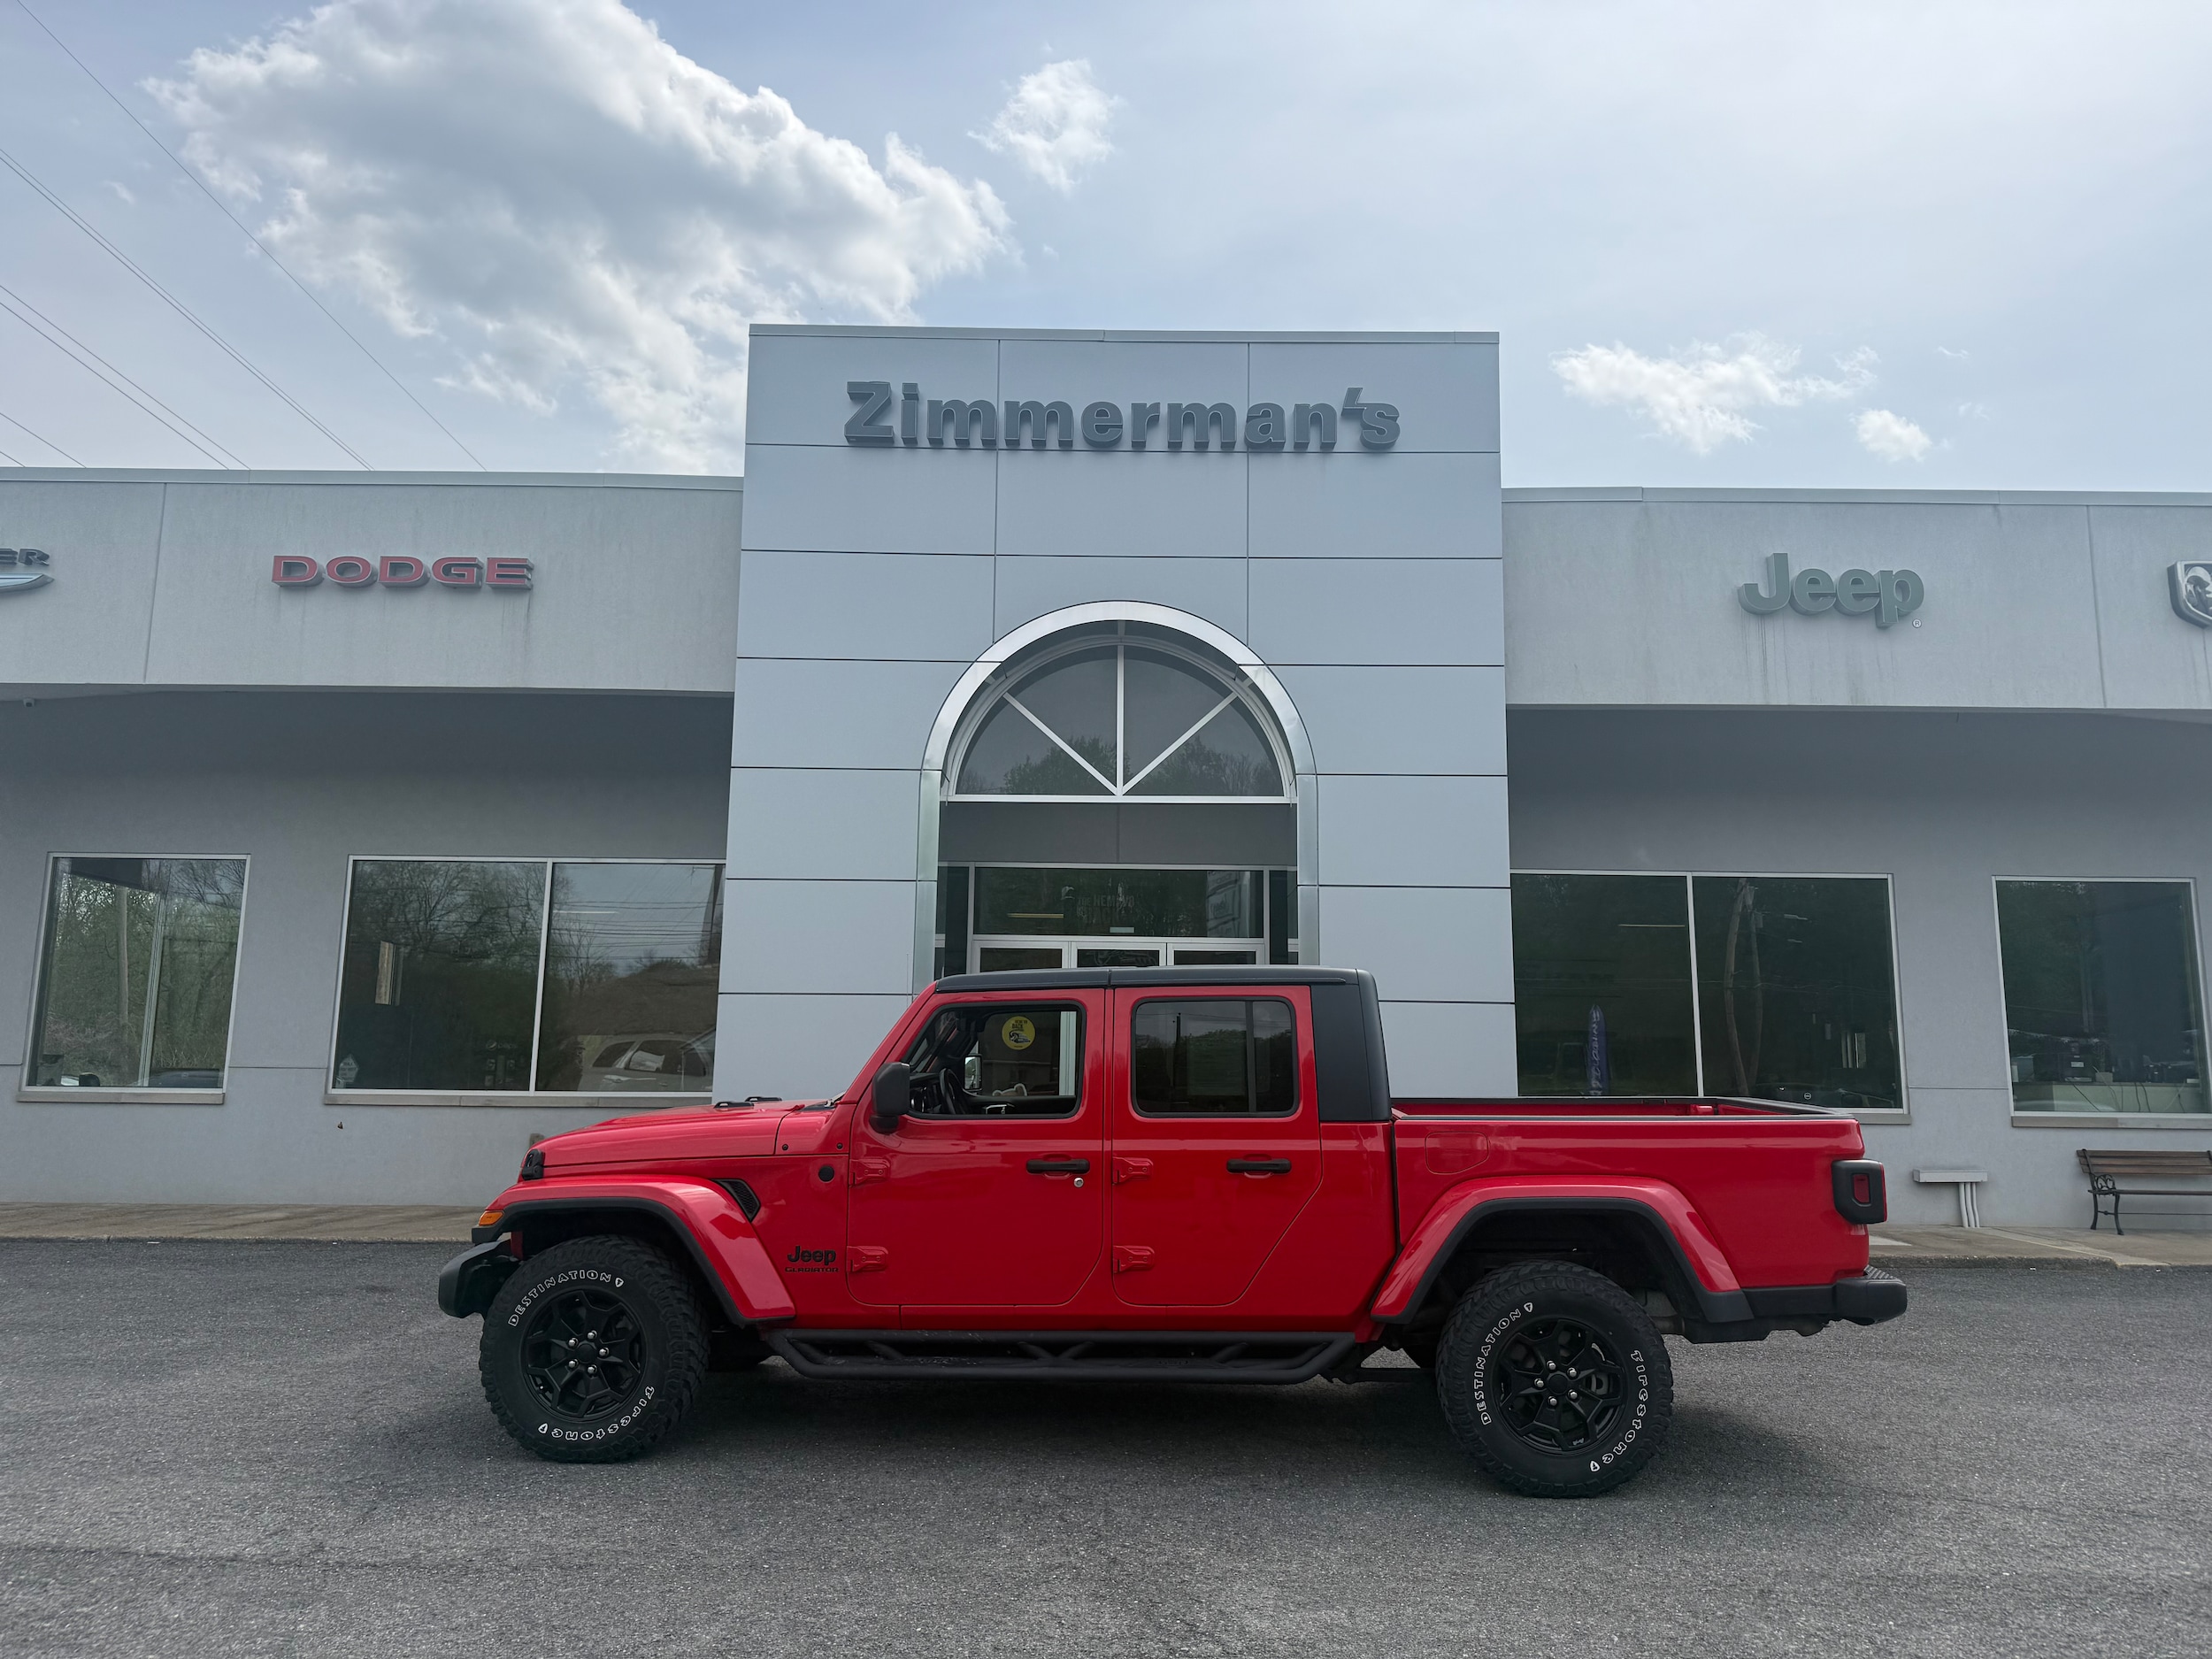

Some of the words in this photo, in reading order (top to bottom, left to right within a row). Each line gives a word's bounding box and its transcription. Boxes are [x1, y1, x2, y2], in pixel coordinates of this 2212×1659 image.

[844, 380, 1401, 449] Zimmerman's
[272, 555, 534, 589] DODGE
[1738, 552, 1924, 628] Jeep
[787, 1245, 836, 1266] Jeep
[508, 1270, 611, 1327] DESTINATION
[1474, 1309, 1522, 1425] DESTINATION
